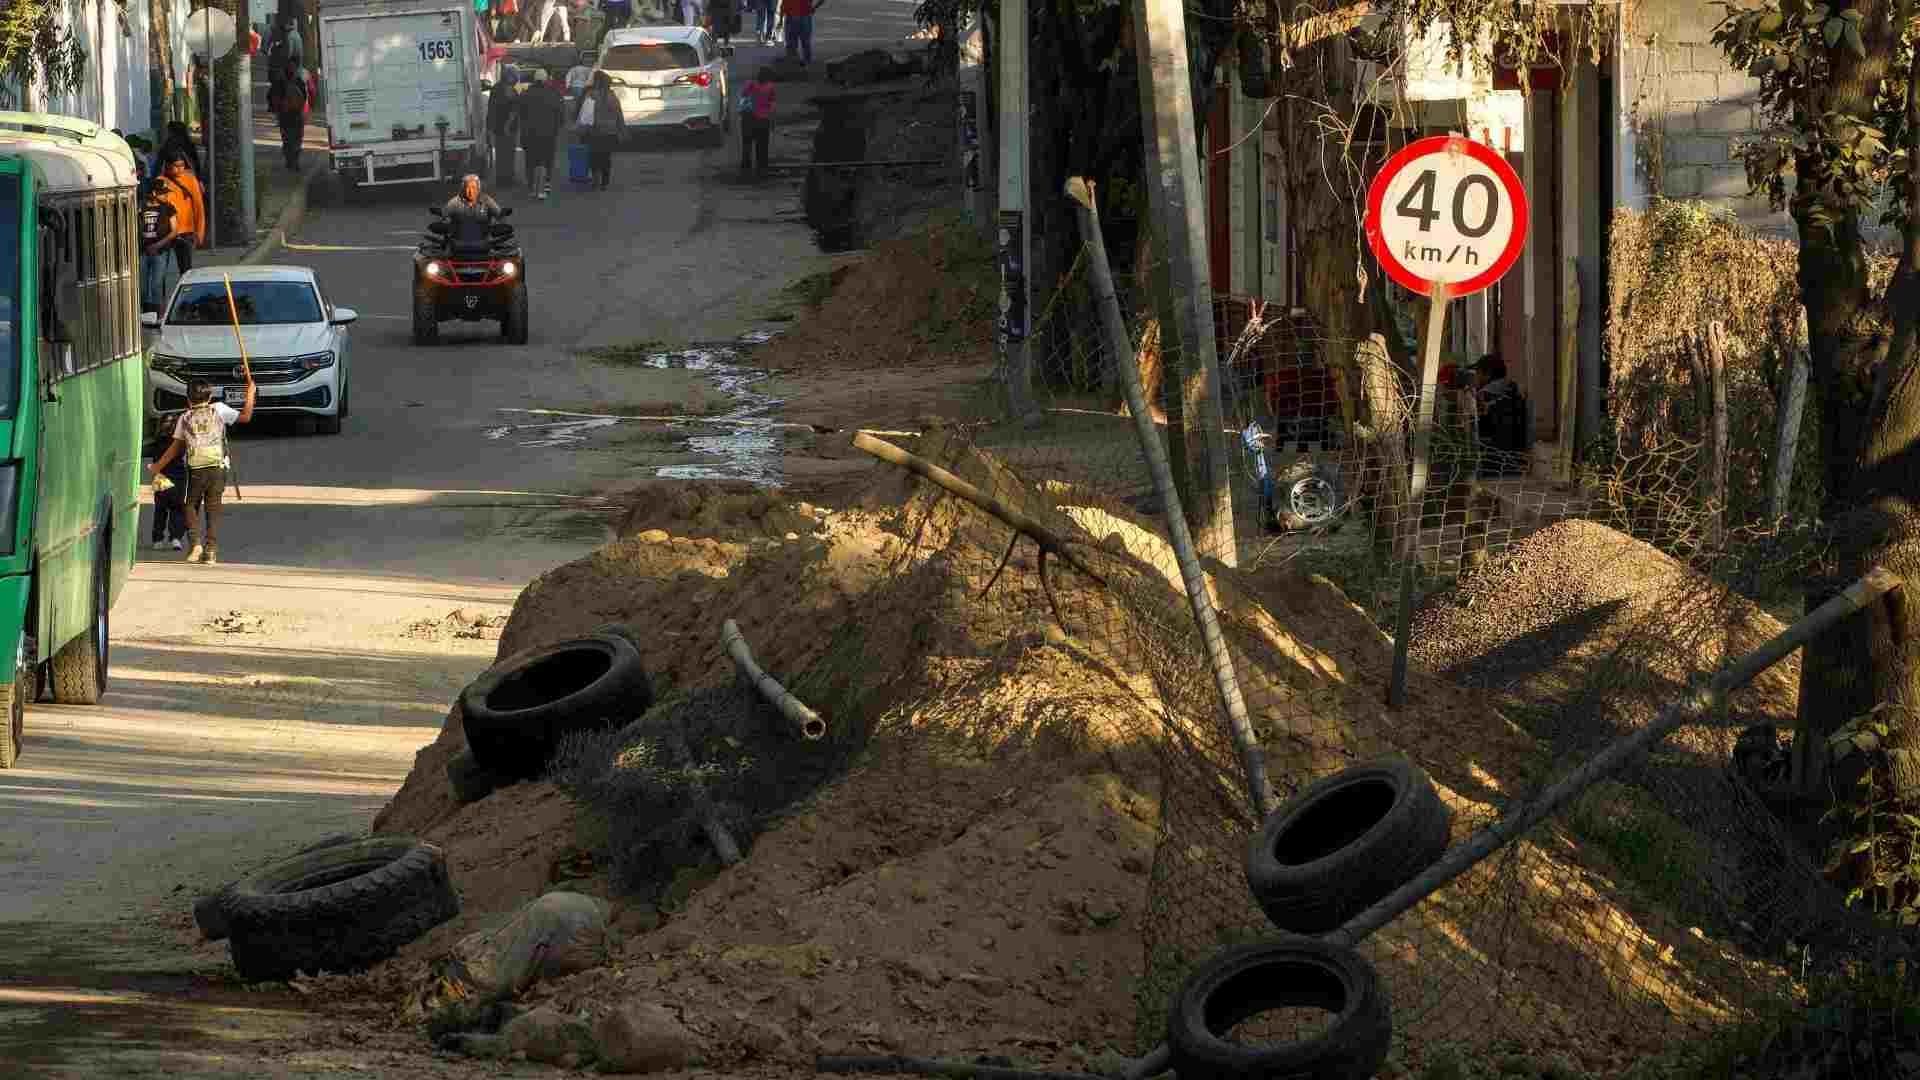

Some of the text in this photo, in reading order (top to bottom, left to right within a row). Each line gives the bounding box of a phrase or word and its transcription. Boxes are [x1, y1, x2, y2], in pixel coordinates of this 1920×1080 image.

[418, 40, 454, 60] 1563
[1396, 170, 1499, 238] 40
[1404, 240, 1479, 265] km/h
